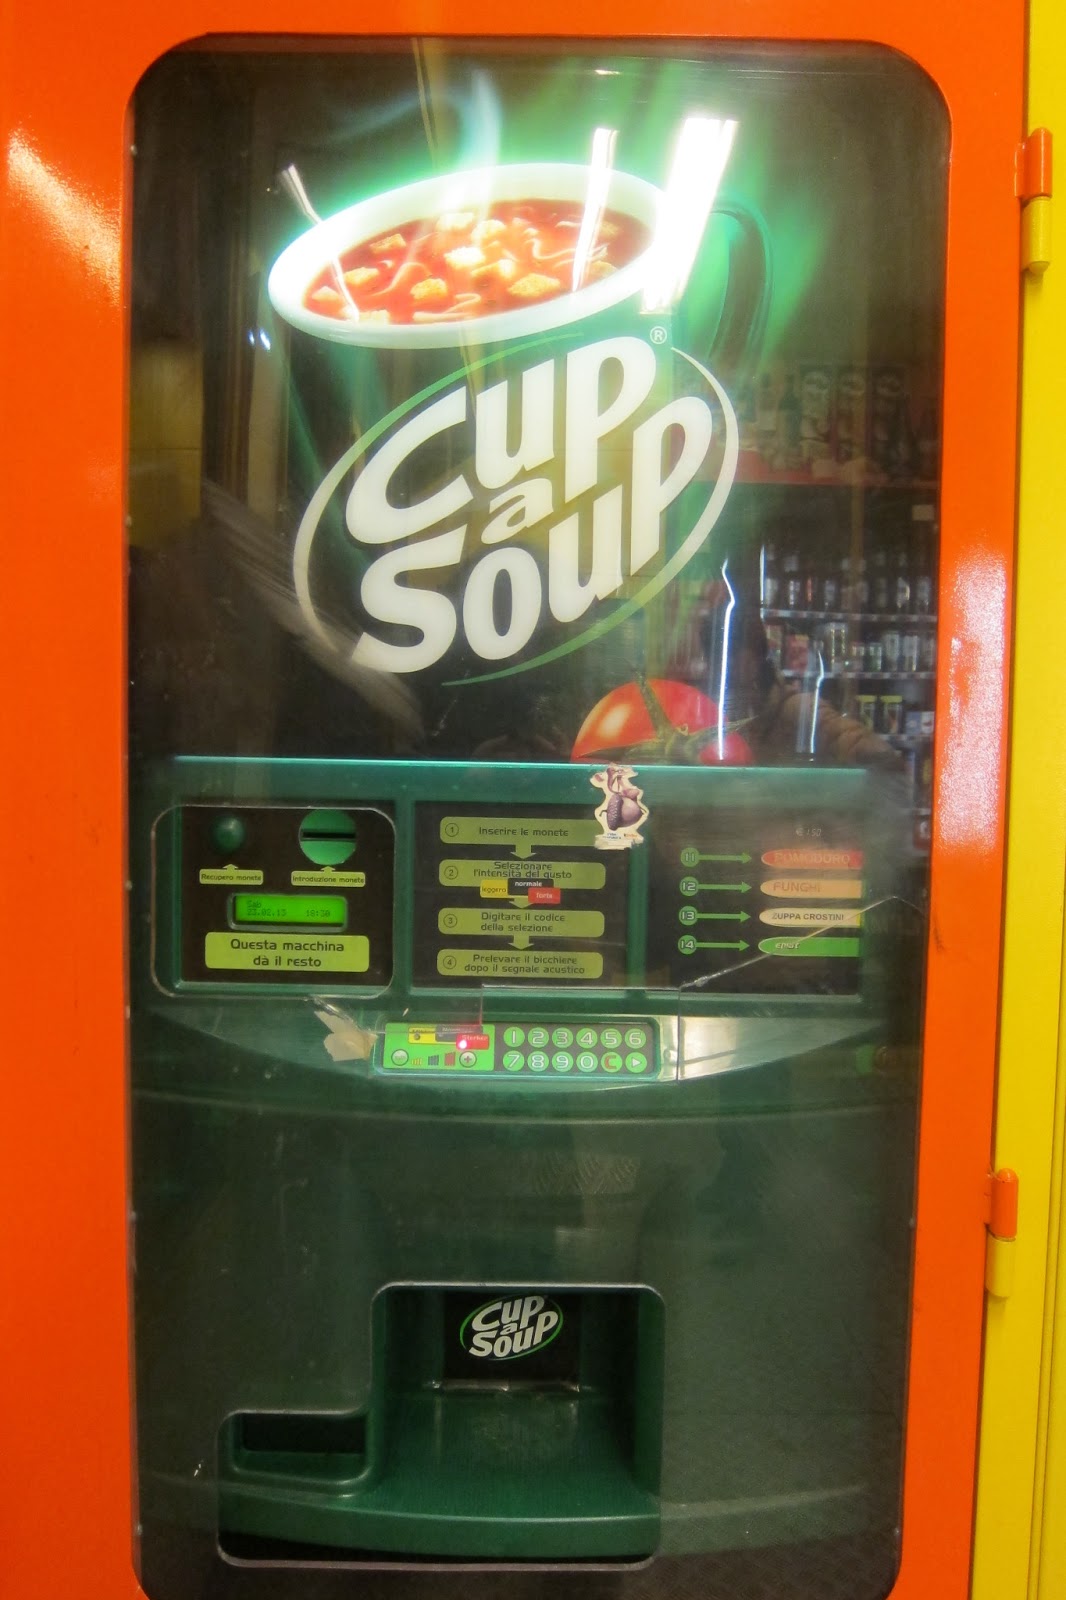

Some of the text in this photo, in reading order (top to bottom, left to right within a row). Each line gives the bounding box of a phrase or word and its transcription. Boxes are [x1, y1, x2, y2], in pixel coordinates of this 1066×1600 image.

[480, 477, 553, 545] a
[479, 827, 517, 836] Inserire
[520, 828, 529, 836] le
[532, 829, 569, 837] monete
[684, 853, 695, 862] 11
[494, 861, 552, 870] Selezionare
[201, 874, 234, 882] Recupero
[525, 869, 539, 878] del
[543, 871, 572, 880] gusto
[682, 882, 820, 892] 12 FUNGHI
[481, 912, 521, 923] Digitare
[524, 913, 530, 921] il
[534, 913, 565, 922] codice
[681, 911, 844, 921] 13 ZUPPA CROSTINI
[481, 923, 553, 932] della selezione
[230, 938, 344, 952] Questa macchina
[680, 940, 694, 949] 14
[253, 955, 322, 967] dà il resto
[473, 954, 521, 963] Prelevare
[524, 955, 530, 963] il
[534, 955, 577, 964] bicchiere
[464, 964, 585, 975] dopo il segnale acustico
[511, 1030, 517, 1043] 1
[532, 1031, 545, 1044] 2
[556, 1031, 568, 1044] 3
[580, 1031, 593, 1045] 4
[604, 1032, 617, 1045] 5
[628, 1032, 642, 1045] 6
[507, 1054, 520, 1067] 7
[531, 1055, 545, 1068] 8
[555, 1055, 568, 1068] 9
[580, 1055, 594, 1068] 0
[604, 1055, 617, 1069] C
[500, 1322, 518, 1336] a
